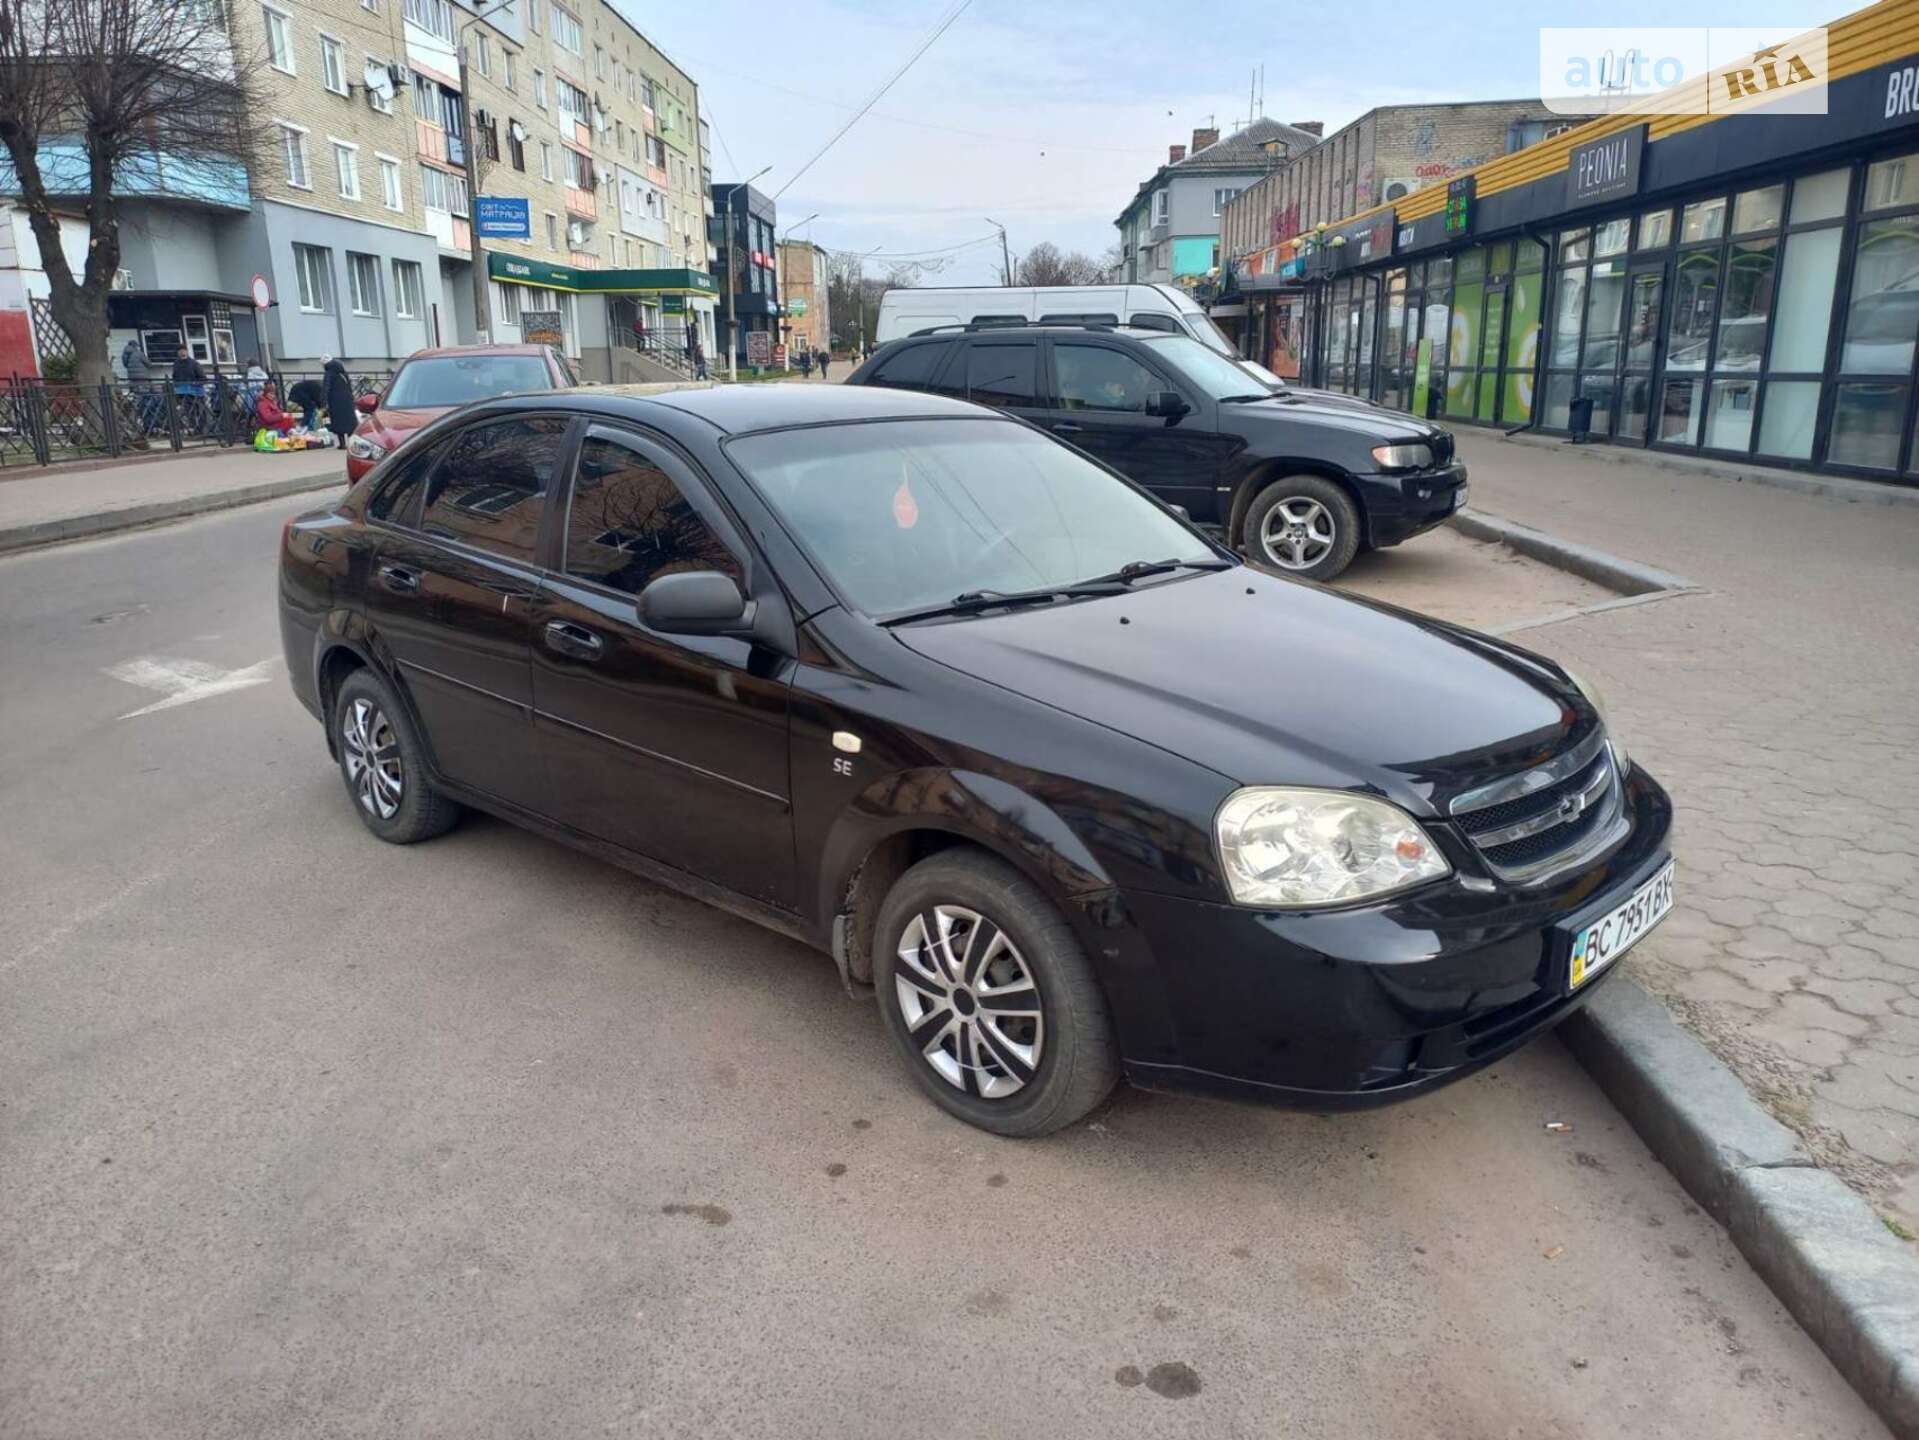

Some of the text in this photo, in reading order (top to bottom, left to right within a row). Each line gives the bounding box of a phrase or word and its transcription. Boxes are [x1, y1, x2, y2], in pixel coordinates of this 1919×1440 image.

[1578, 137, 1628, 190] PEONIA
[833, 757, 852, 776] SE
[1585, 919, 1611, 968] BC
[1616, 889, 1652, 948] 7951
